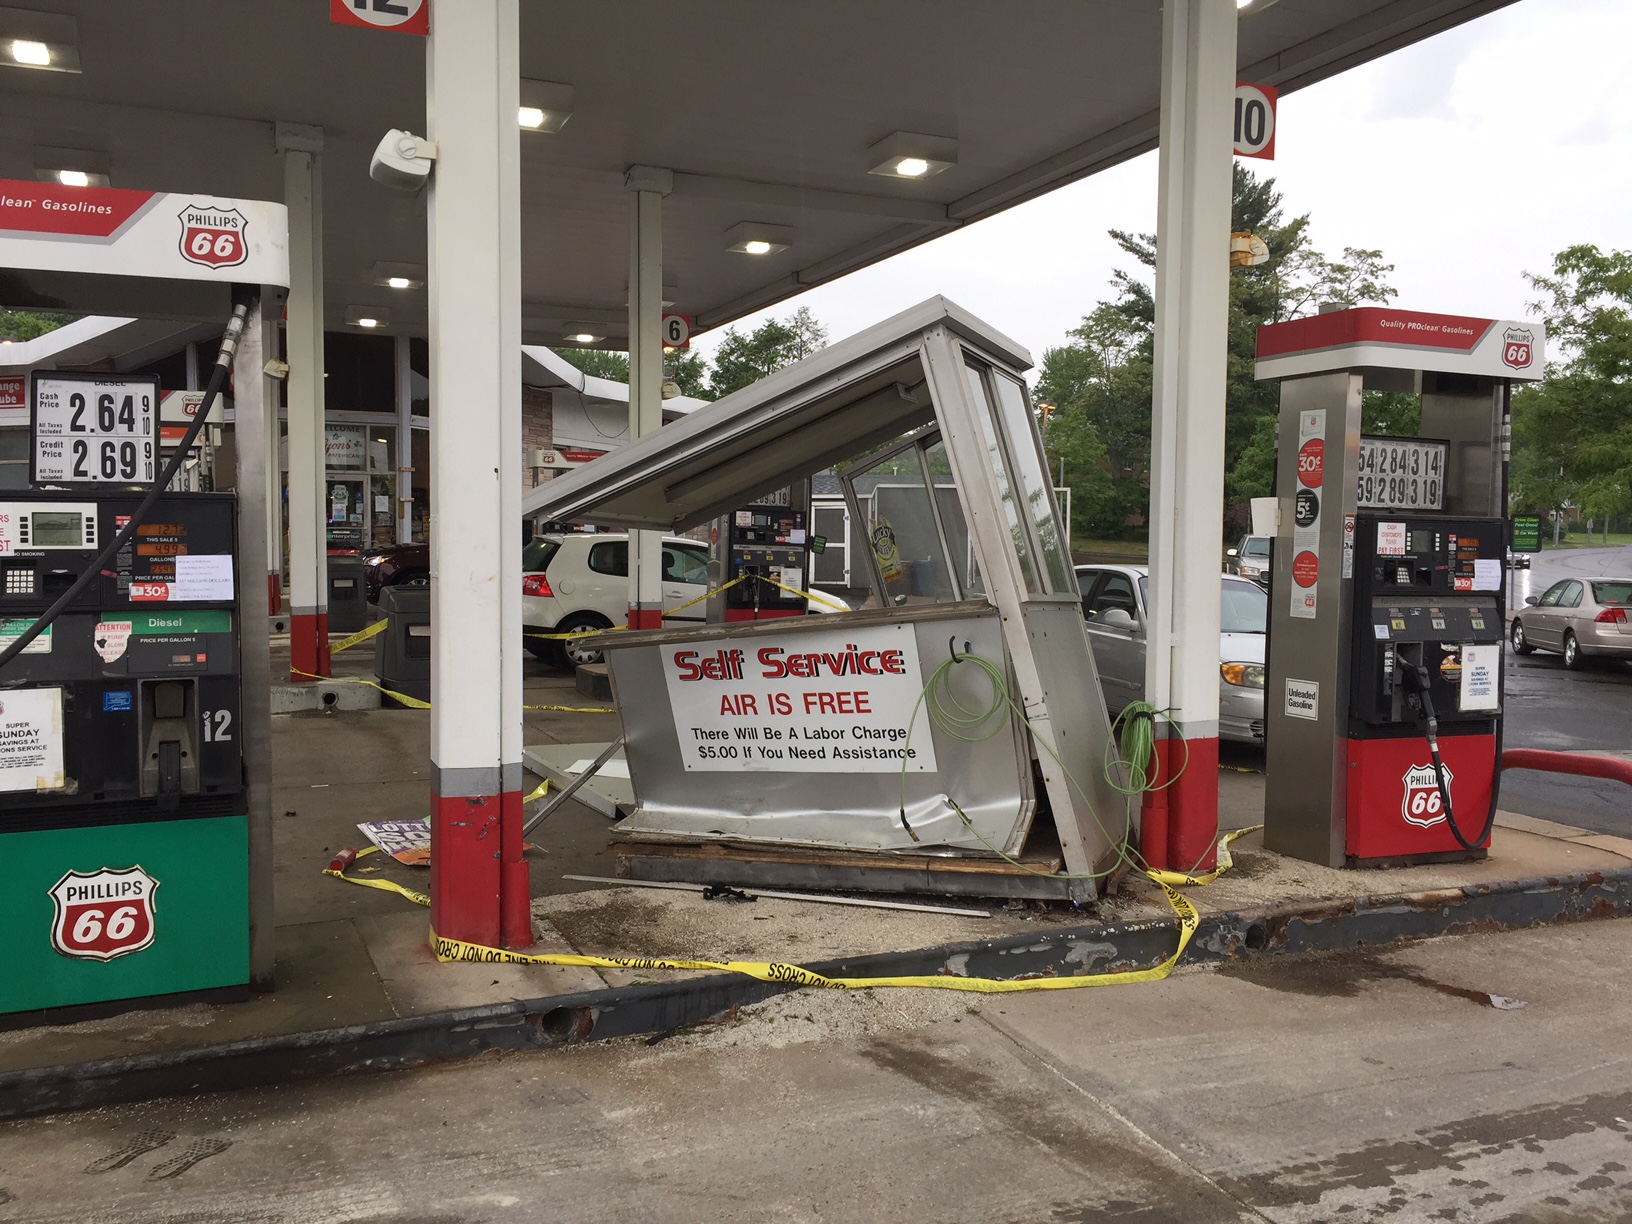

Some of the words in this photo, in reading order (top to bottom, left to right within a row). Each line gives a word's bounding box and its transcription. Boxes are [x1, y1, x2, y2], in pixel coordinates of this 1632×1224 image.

[41, 199, 112, 214] Gasolines
[187, 213, 238, 228] PHILLIPS
[191, 232, 235, 257] 66
[669, 320, 681, 342] 6
[1380, 319, 1406, 330] Quality
[1441, 326, 1474, 335] Gasolines
[1506, 333, 1530, 343] PHILLIPS
[1507, 345, 1528, 362] 66
[40, 392, 59, 400] Cash
[39, 400, 60, 408] Price
[69, 392, 136, 433] 2.64
[40, 441, 64, 449] Credit
[42, 450, 63, 458] Price
[73, 439, 137, 480] 2.69
[95, 623, 131, 632] ATTENTION
[148, 618, 182, 628] Diesel
[674, 649, 745, 681] Self
[757, 643, 906, 679] Service
[1288, 687, 1316, 700] Unleaded
[720, 694, 758, 716] AIR
[767, 692, 793, 716] IS
[803, 691, 872, 714] FREE
[1288, 697, 1313, 710] Gasoline
[691, 727, 730, 740] There
[734, 727, 758, 740] Will
[763, 727, 782, 740] Be
[789, 727, 799, 740] A
[803, 726, 845, 740] Labor
[852, 725, 907, 742] Charge
[17, 744, 48, 753] SERVICE
[698, 745, 738, 759] $5.00
[743, 745, 752, 759] If
[757, 745, 784, 759] You
[788, 746, 826, 759] Need
[832, 745, 917, 759] Assistance
[1410, 774, 1438, 786] PHILLI
[1411, 790, 1441, 815] 66
[367, 822, 429, 833] LOTT
[66, 880, 143, 902] PHILLIPS
[72, 906, 138, 944] 66
[460, 944, 484, 961] NOT
